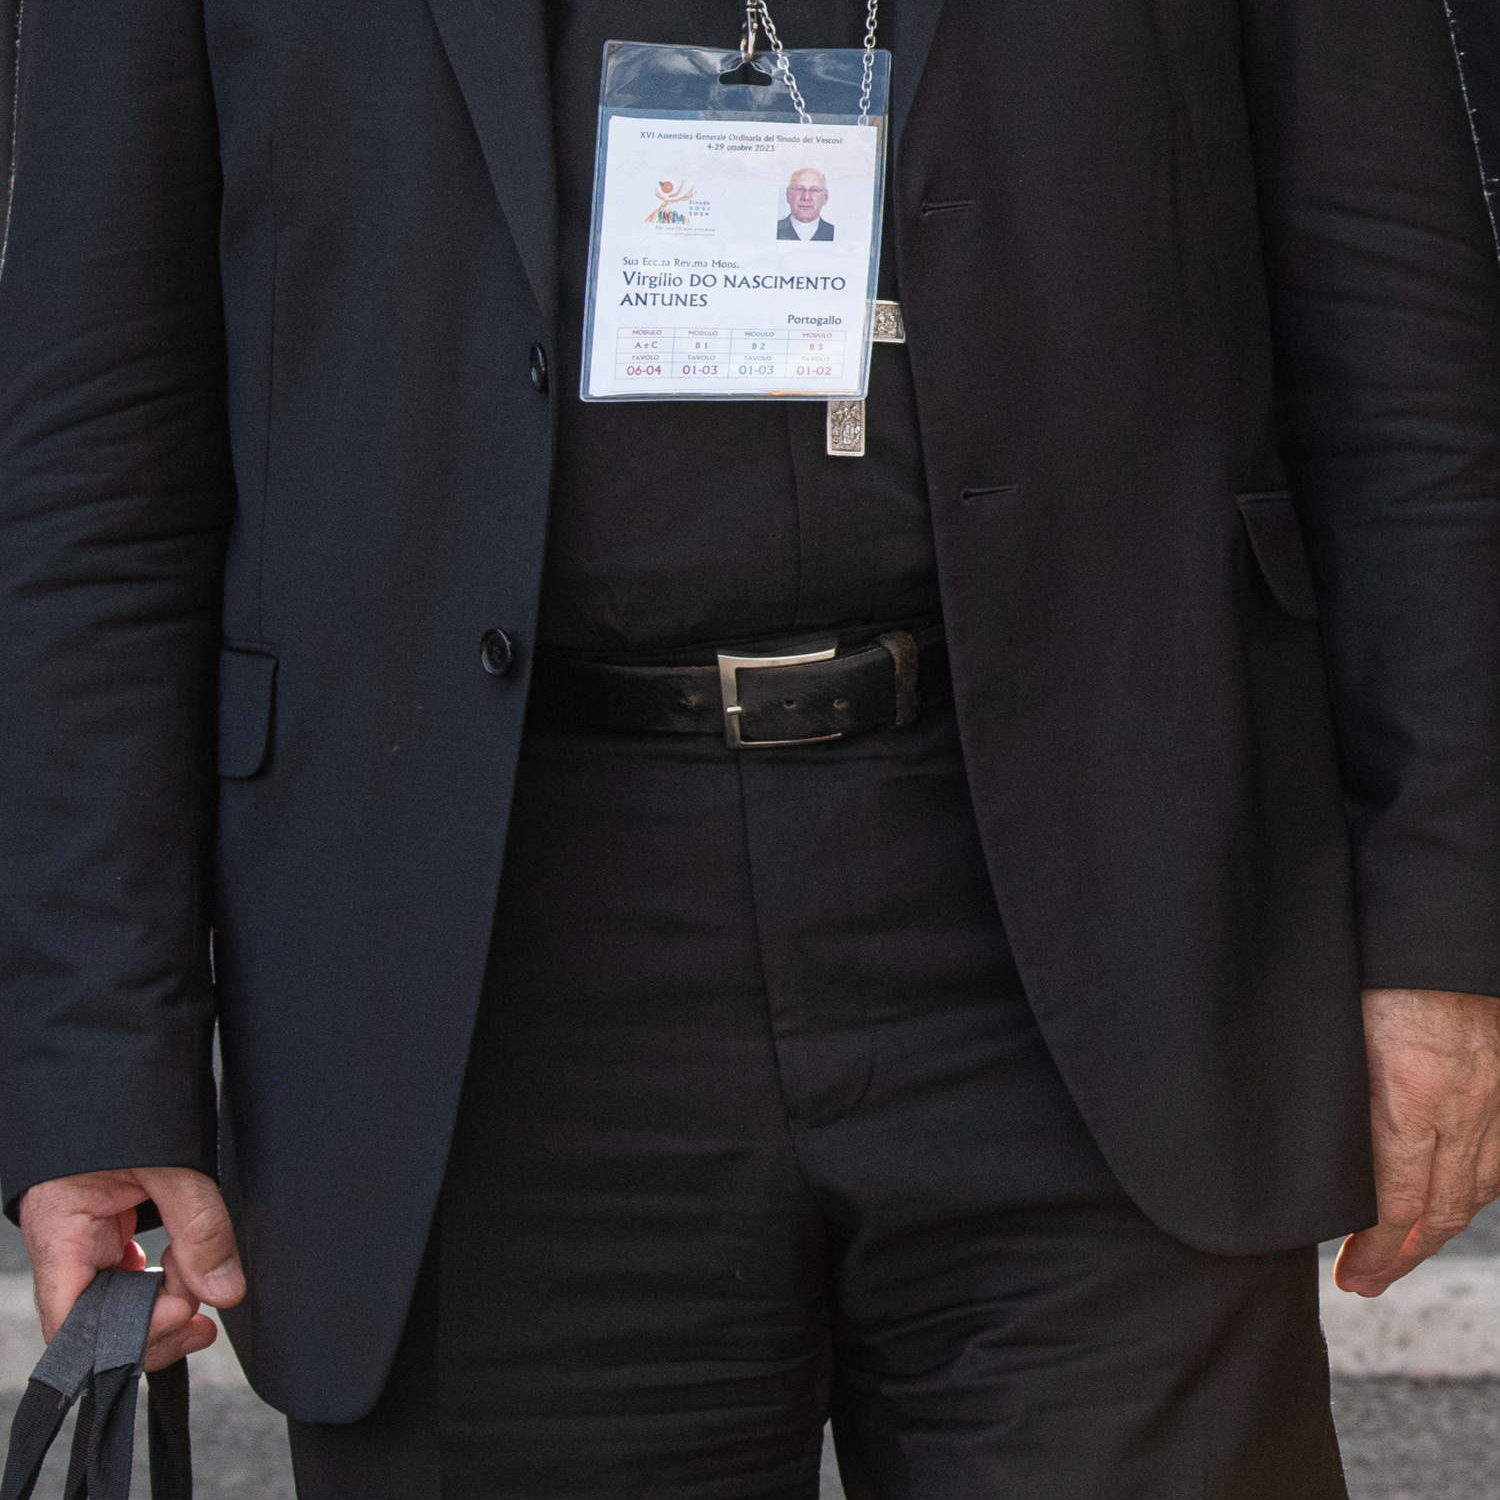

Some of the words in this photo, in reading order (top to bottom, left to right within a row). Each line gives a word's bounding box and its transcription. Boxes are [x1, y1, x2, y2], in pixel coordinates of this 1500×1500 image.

[695, 133, 726, 141] Generale
[728, 134, 761, 142] Ordinaria
[776, 135, 800, 143] Sinodo
[816, 136, 842, 144] Vescovi
[755, 144, 775, 152] 2023
[623, 256, 638, 265] Sua
[642, 257, 670, 266] Ecc.za
[674, 258, 707, 267] Rev.ma
[712, 259, 739, 268] Mons.
[622, 271, 682, 288] Virgílio
[690, 274, 717, 287] DO
[724, 275, 846, 290] NASCIMENTO
[619, 293, 707, 307] ANTUNES
[788, 314, 842, 326] Portogallo
[627, 365, 661, 375] 06-04
[682, 365, 718, 375] 01-03
[739, 365, 774, 375] 01-03
[796, 366, 831, 375] 01-02
